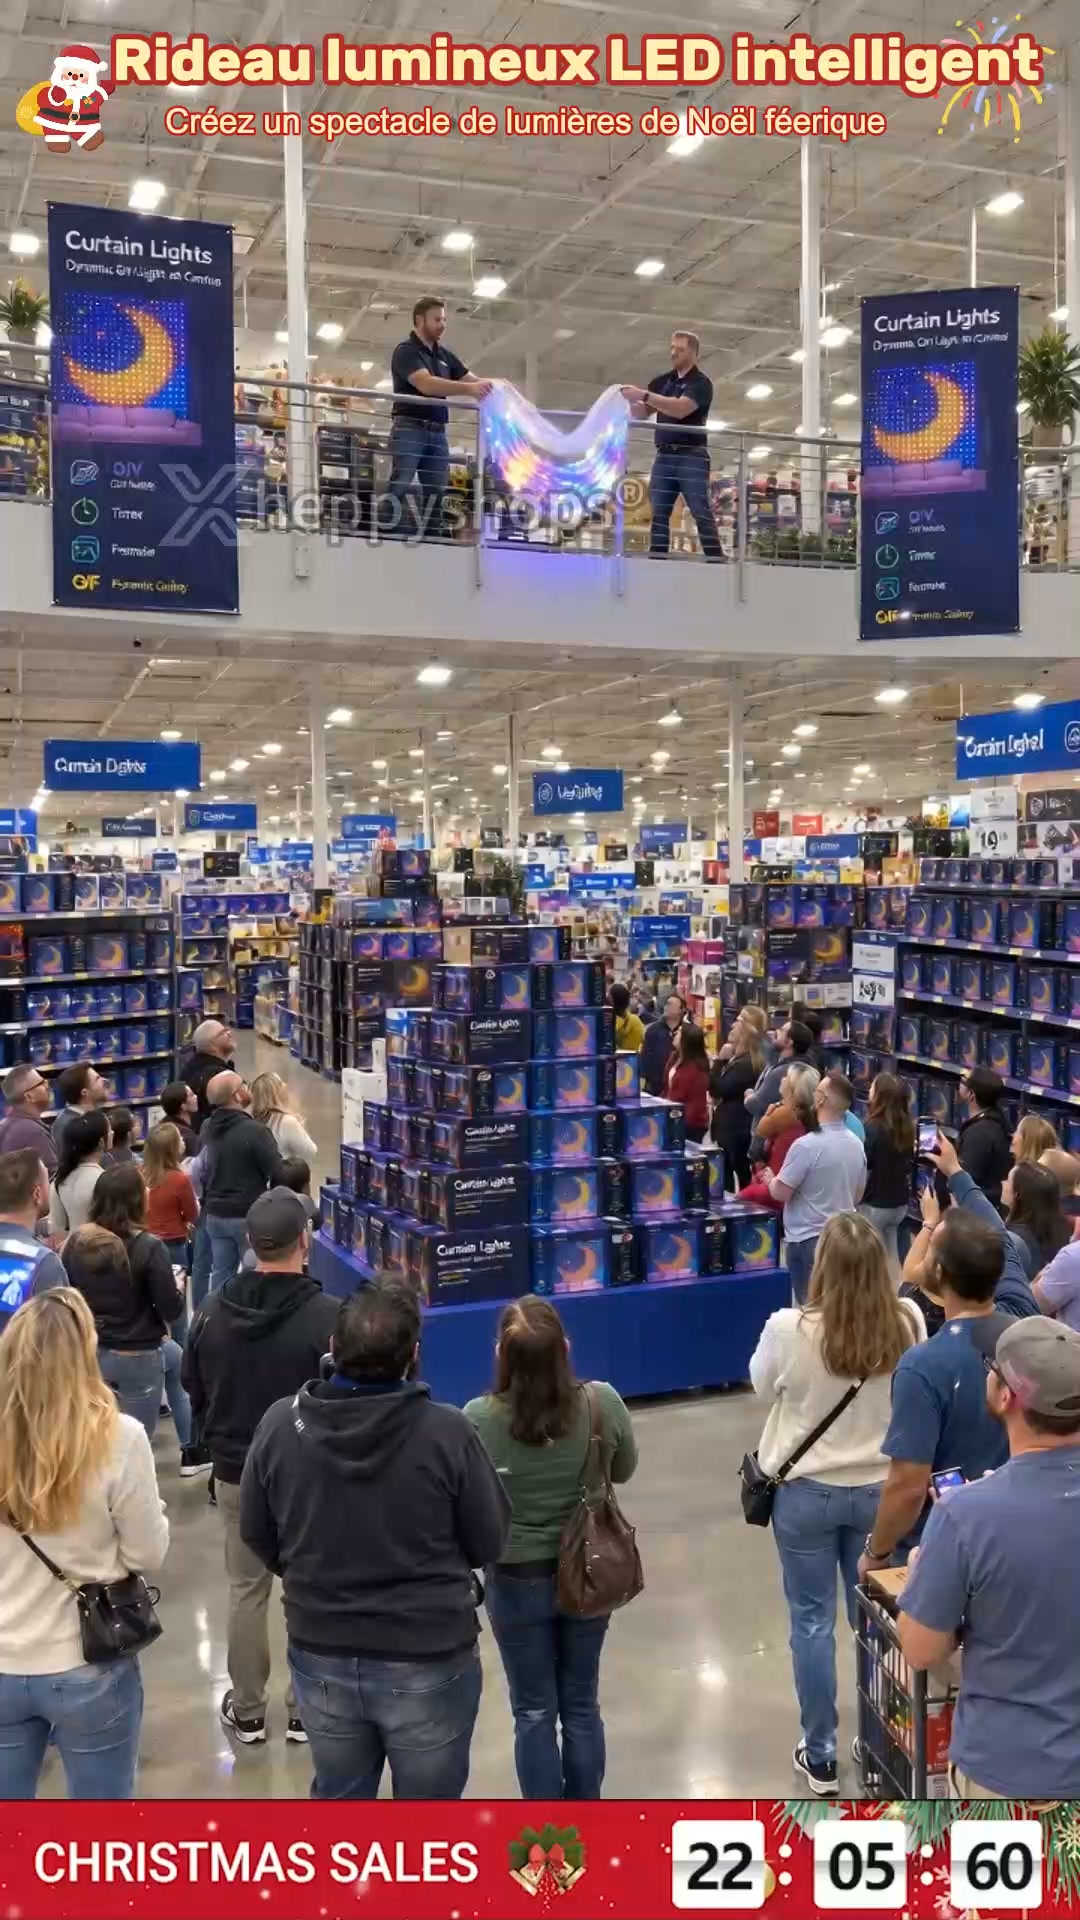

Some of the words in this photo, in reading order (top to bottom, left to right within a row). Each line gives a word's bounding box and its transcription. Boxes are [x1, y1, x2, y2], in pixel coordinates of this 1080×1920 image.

[65, 230, 144, 256] Curtain
[150, 239, 213, 266] Lights
[873, 311, 941, 333] Curtain
[946, 308, 1001, 331] Lights
